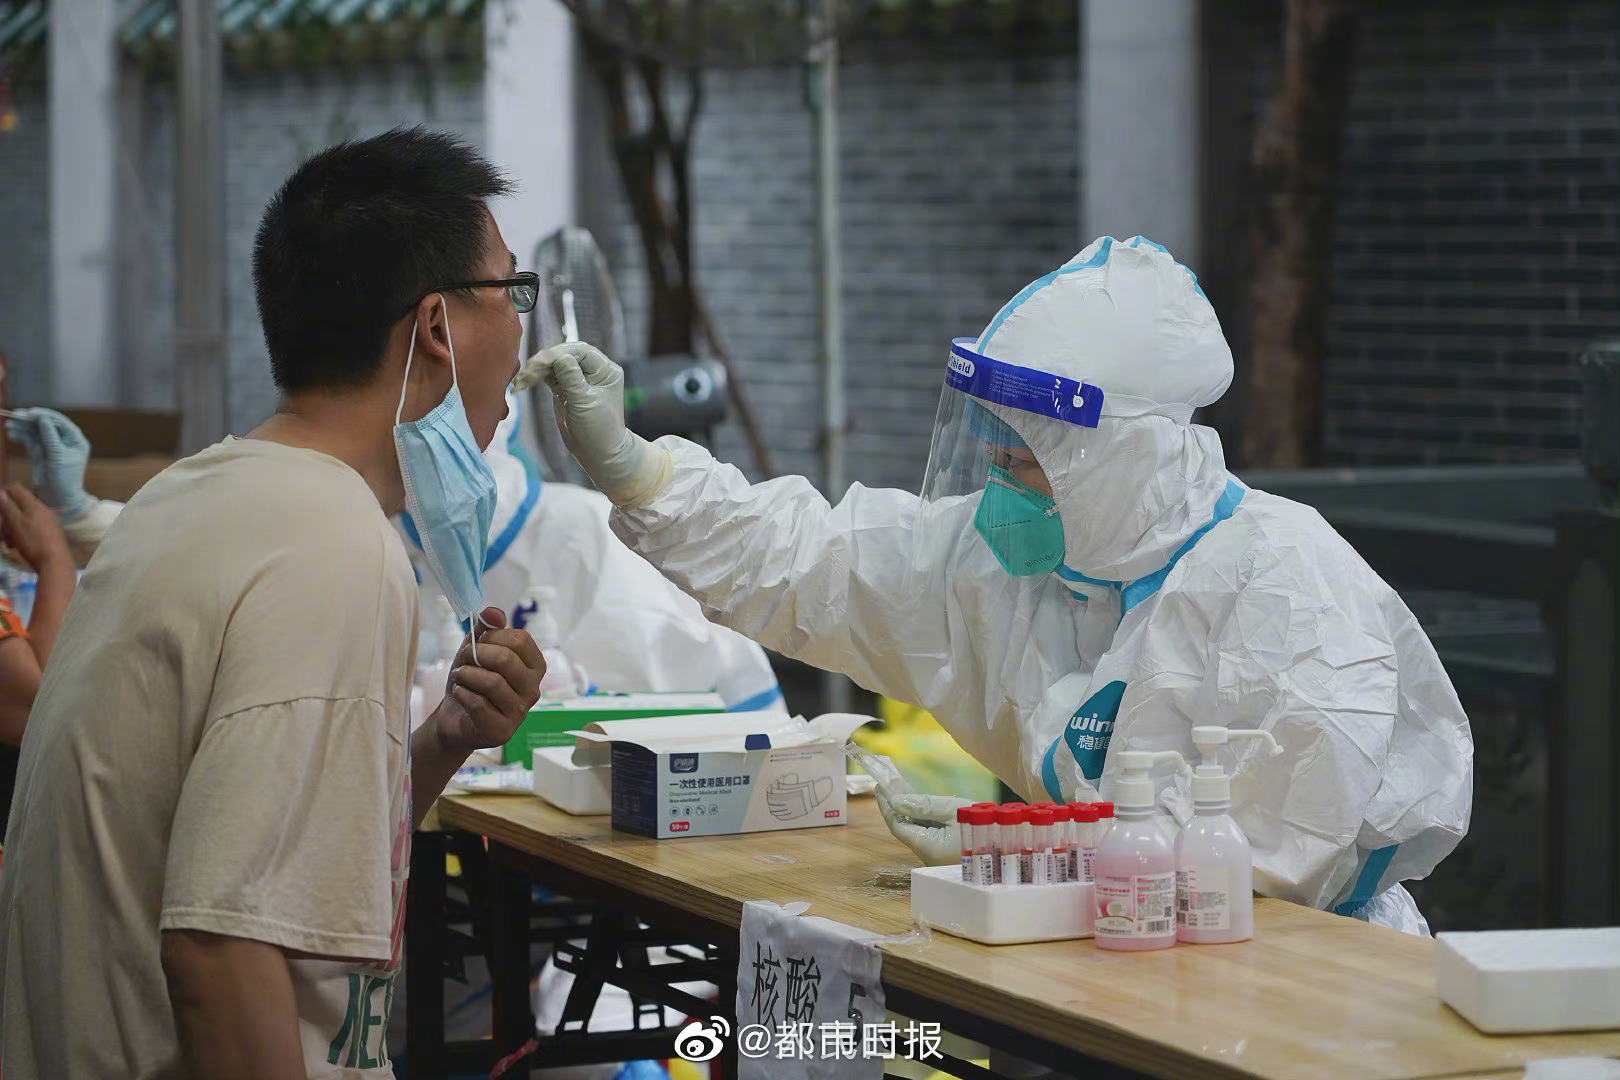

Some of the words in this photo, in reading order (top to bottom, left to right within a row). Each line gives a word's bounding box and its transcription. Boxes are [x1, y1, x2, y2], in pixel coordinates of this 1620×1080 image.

[669, 775, 751, 789] 一次性使用医用口罩
[751, 940, 822, 1045] 核酸
[847, 982, 867, 1049] 5
